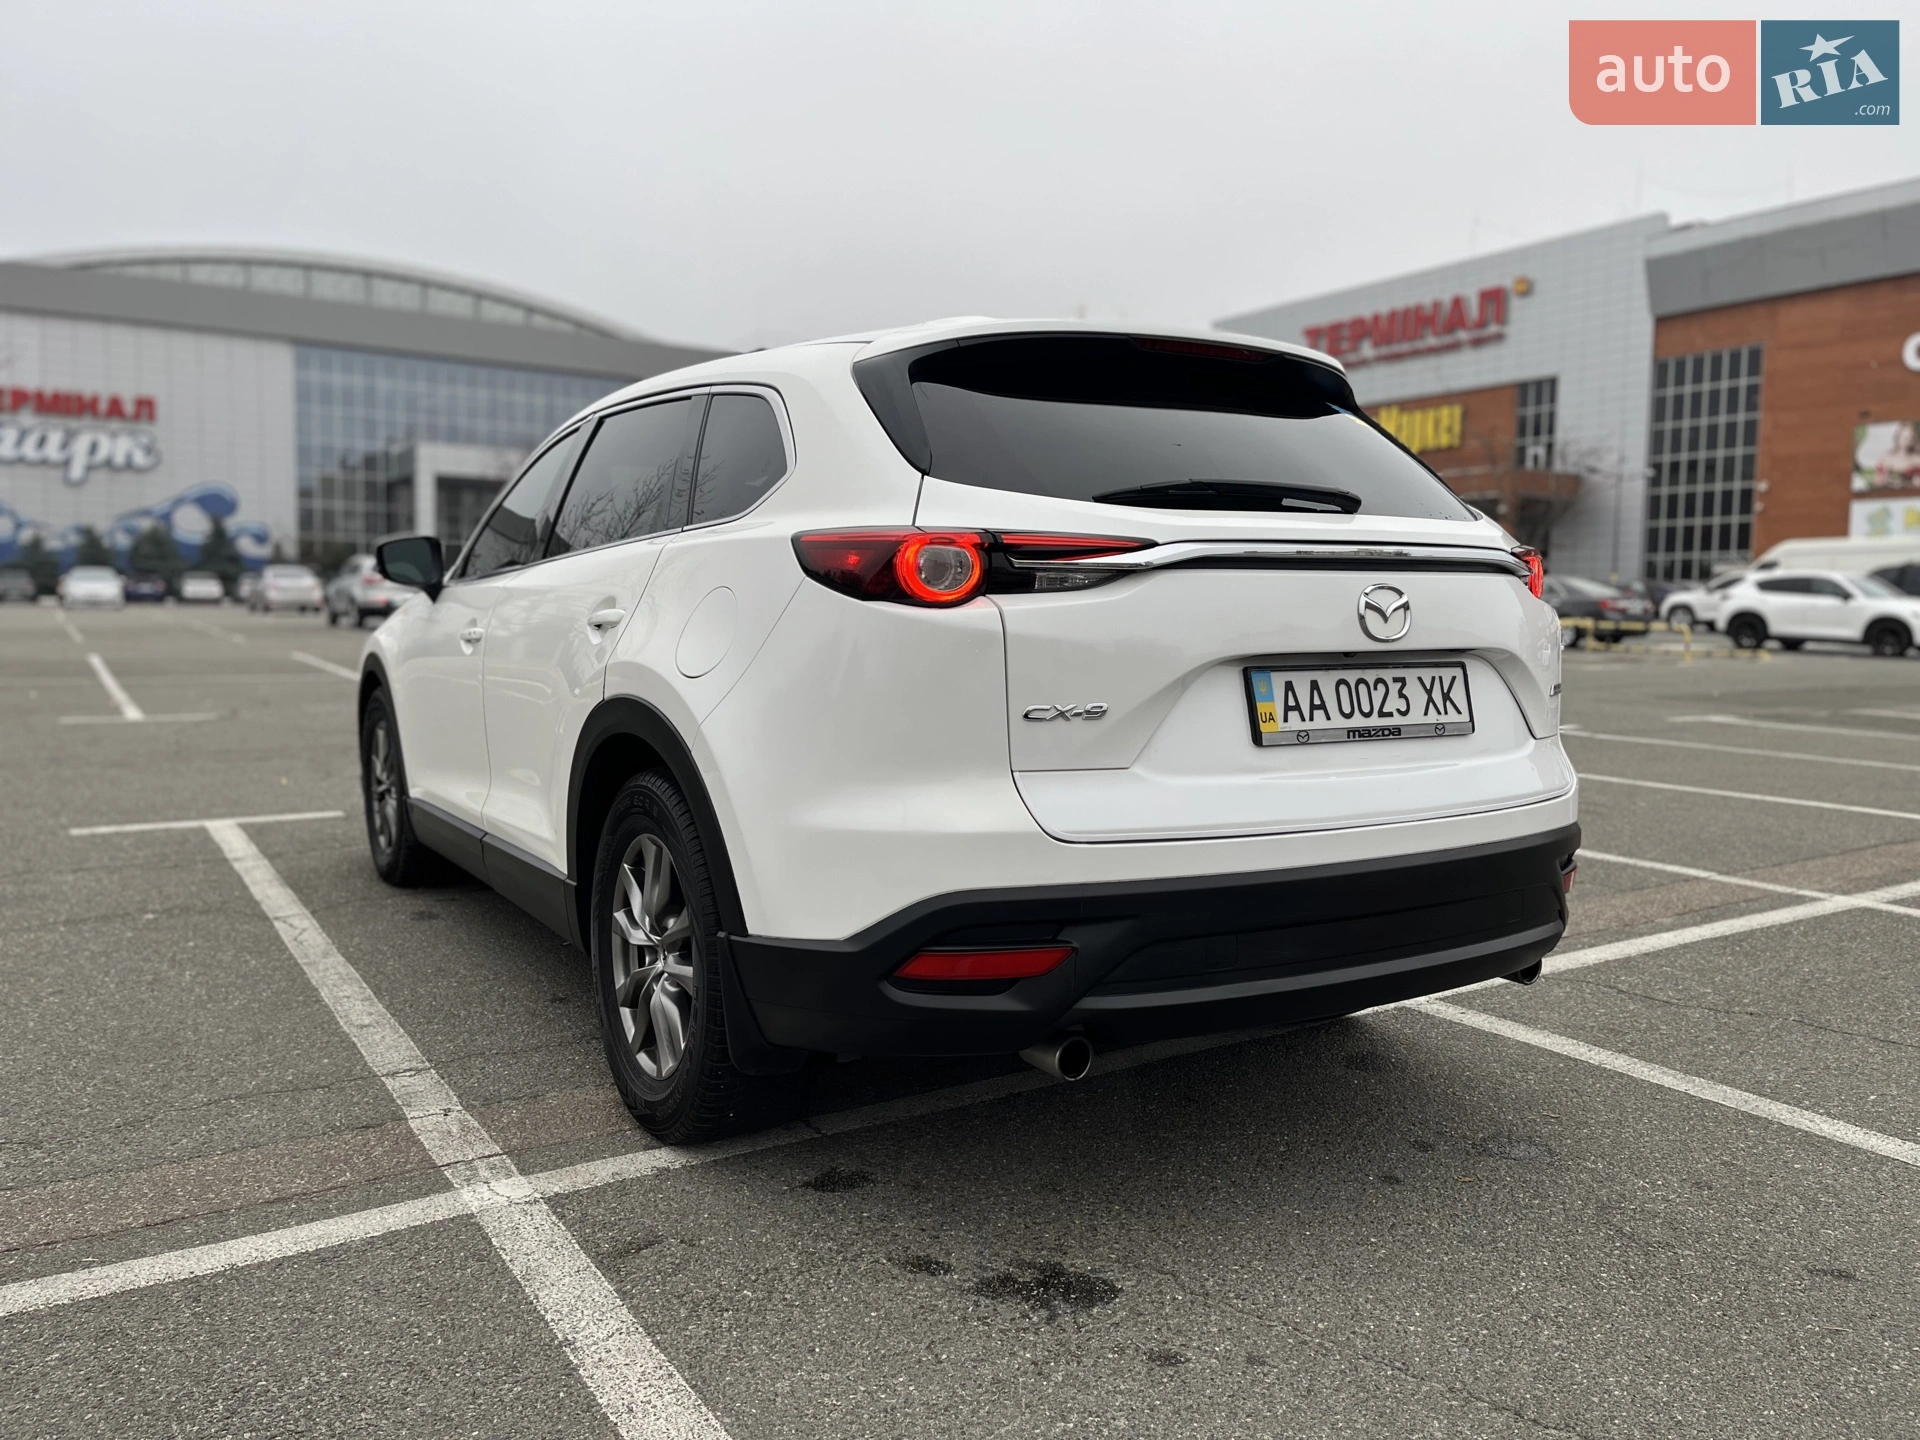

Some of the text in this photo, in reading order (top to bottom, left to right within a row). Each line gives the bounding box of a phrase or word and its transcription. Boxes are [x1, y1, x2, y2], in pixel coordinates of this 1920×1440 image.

[1303, 285, 1507, 357] ТЕРМІНАЛ
[1022, 702, 1109, 722] CX-9
[1282, 675, 1463, 723] AA 0023 XK
[1260, 711, 1276, 724] UA
